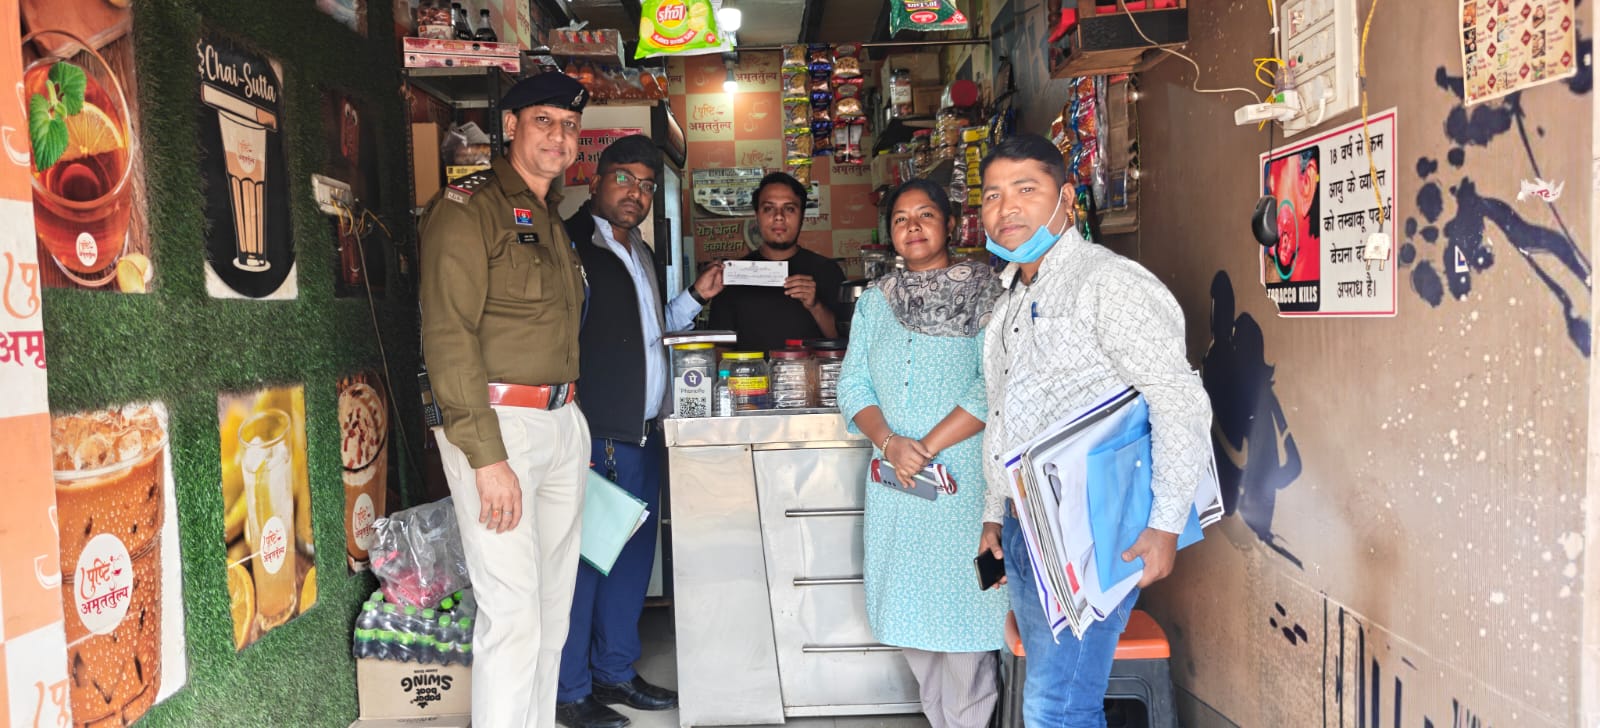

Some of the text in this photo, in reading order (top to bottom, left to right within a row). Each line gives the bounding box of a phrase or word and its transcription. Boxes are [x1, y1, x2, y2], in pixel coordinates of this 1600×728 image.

[205, 44, 277, 103] Chai-Sutta
[1330, 149, 1338, 166] 18
[1340, 135, 1352, 160] वर्ष
[1355, 133, 1363, 157] से
[1329, 180, 1344, 203] आयु
[1346, 170, 1356, 193] के
[1323, 209, 1335, 233] को
[1330, 242, 1352, 264] बेचना
[1299, 285, 1318, 303] KILLS
[1337, 279, 1363, 298] अपराध
[400, 674, 454, 692] SWING
[415, 687, 437, 695] boat
[413, 692, 442, 702] paper
